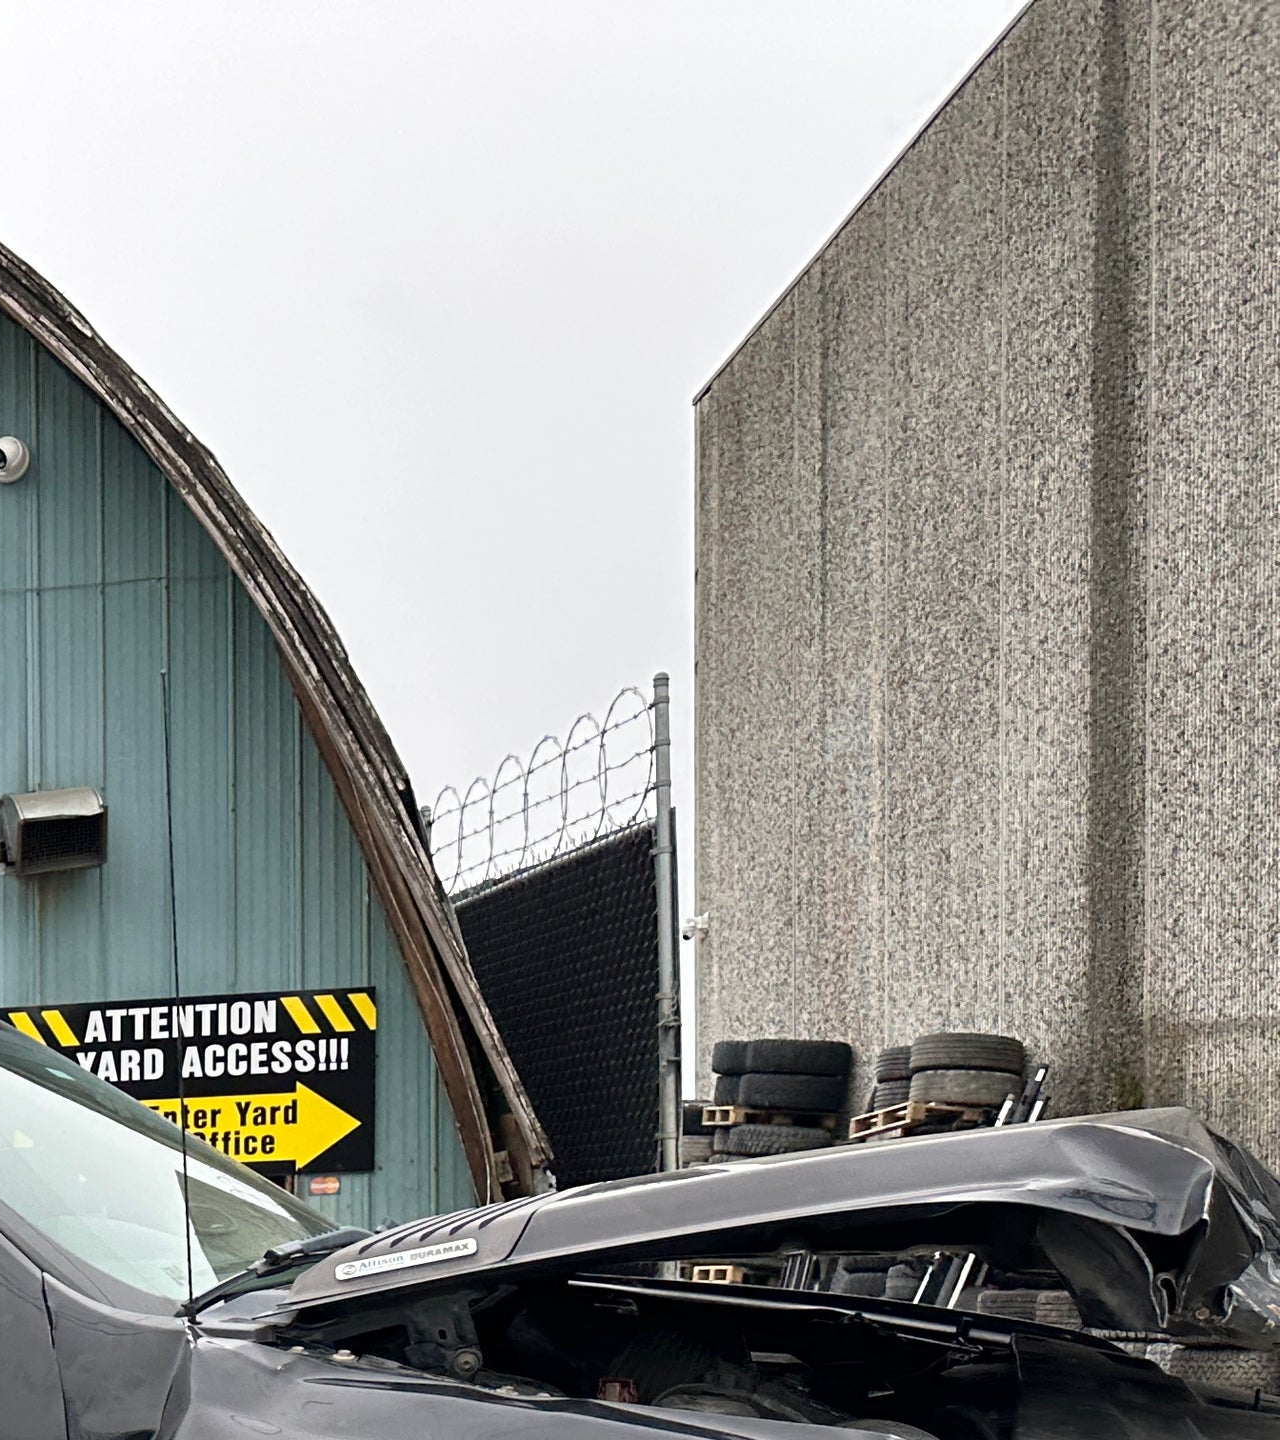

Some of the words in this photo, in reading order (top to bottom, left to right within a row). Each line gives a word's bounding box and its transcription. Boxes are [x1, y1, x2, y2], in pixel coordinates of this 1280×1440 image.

[83, 999, 278, 1044] ATTENTION
[75, 1047, 165, 1083] YARD
[181, 1037, 350, 1079] ACCESS!!!
[235, 1099, 298, 1127] Yard
[409, 1242, 470, 1262] DURAMAX
